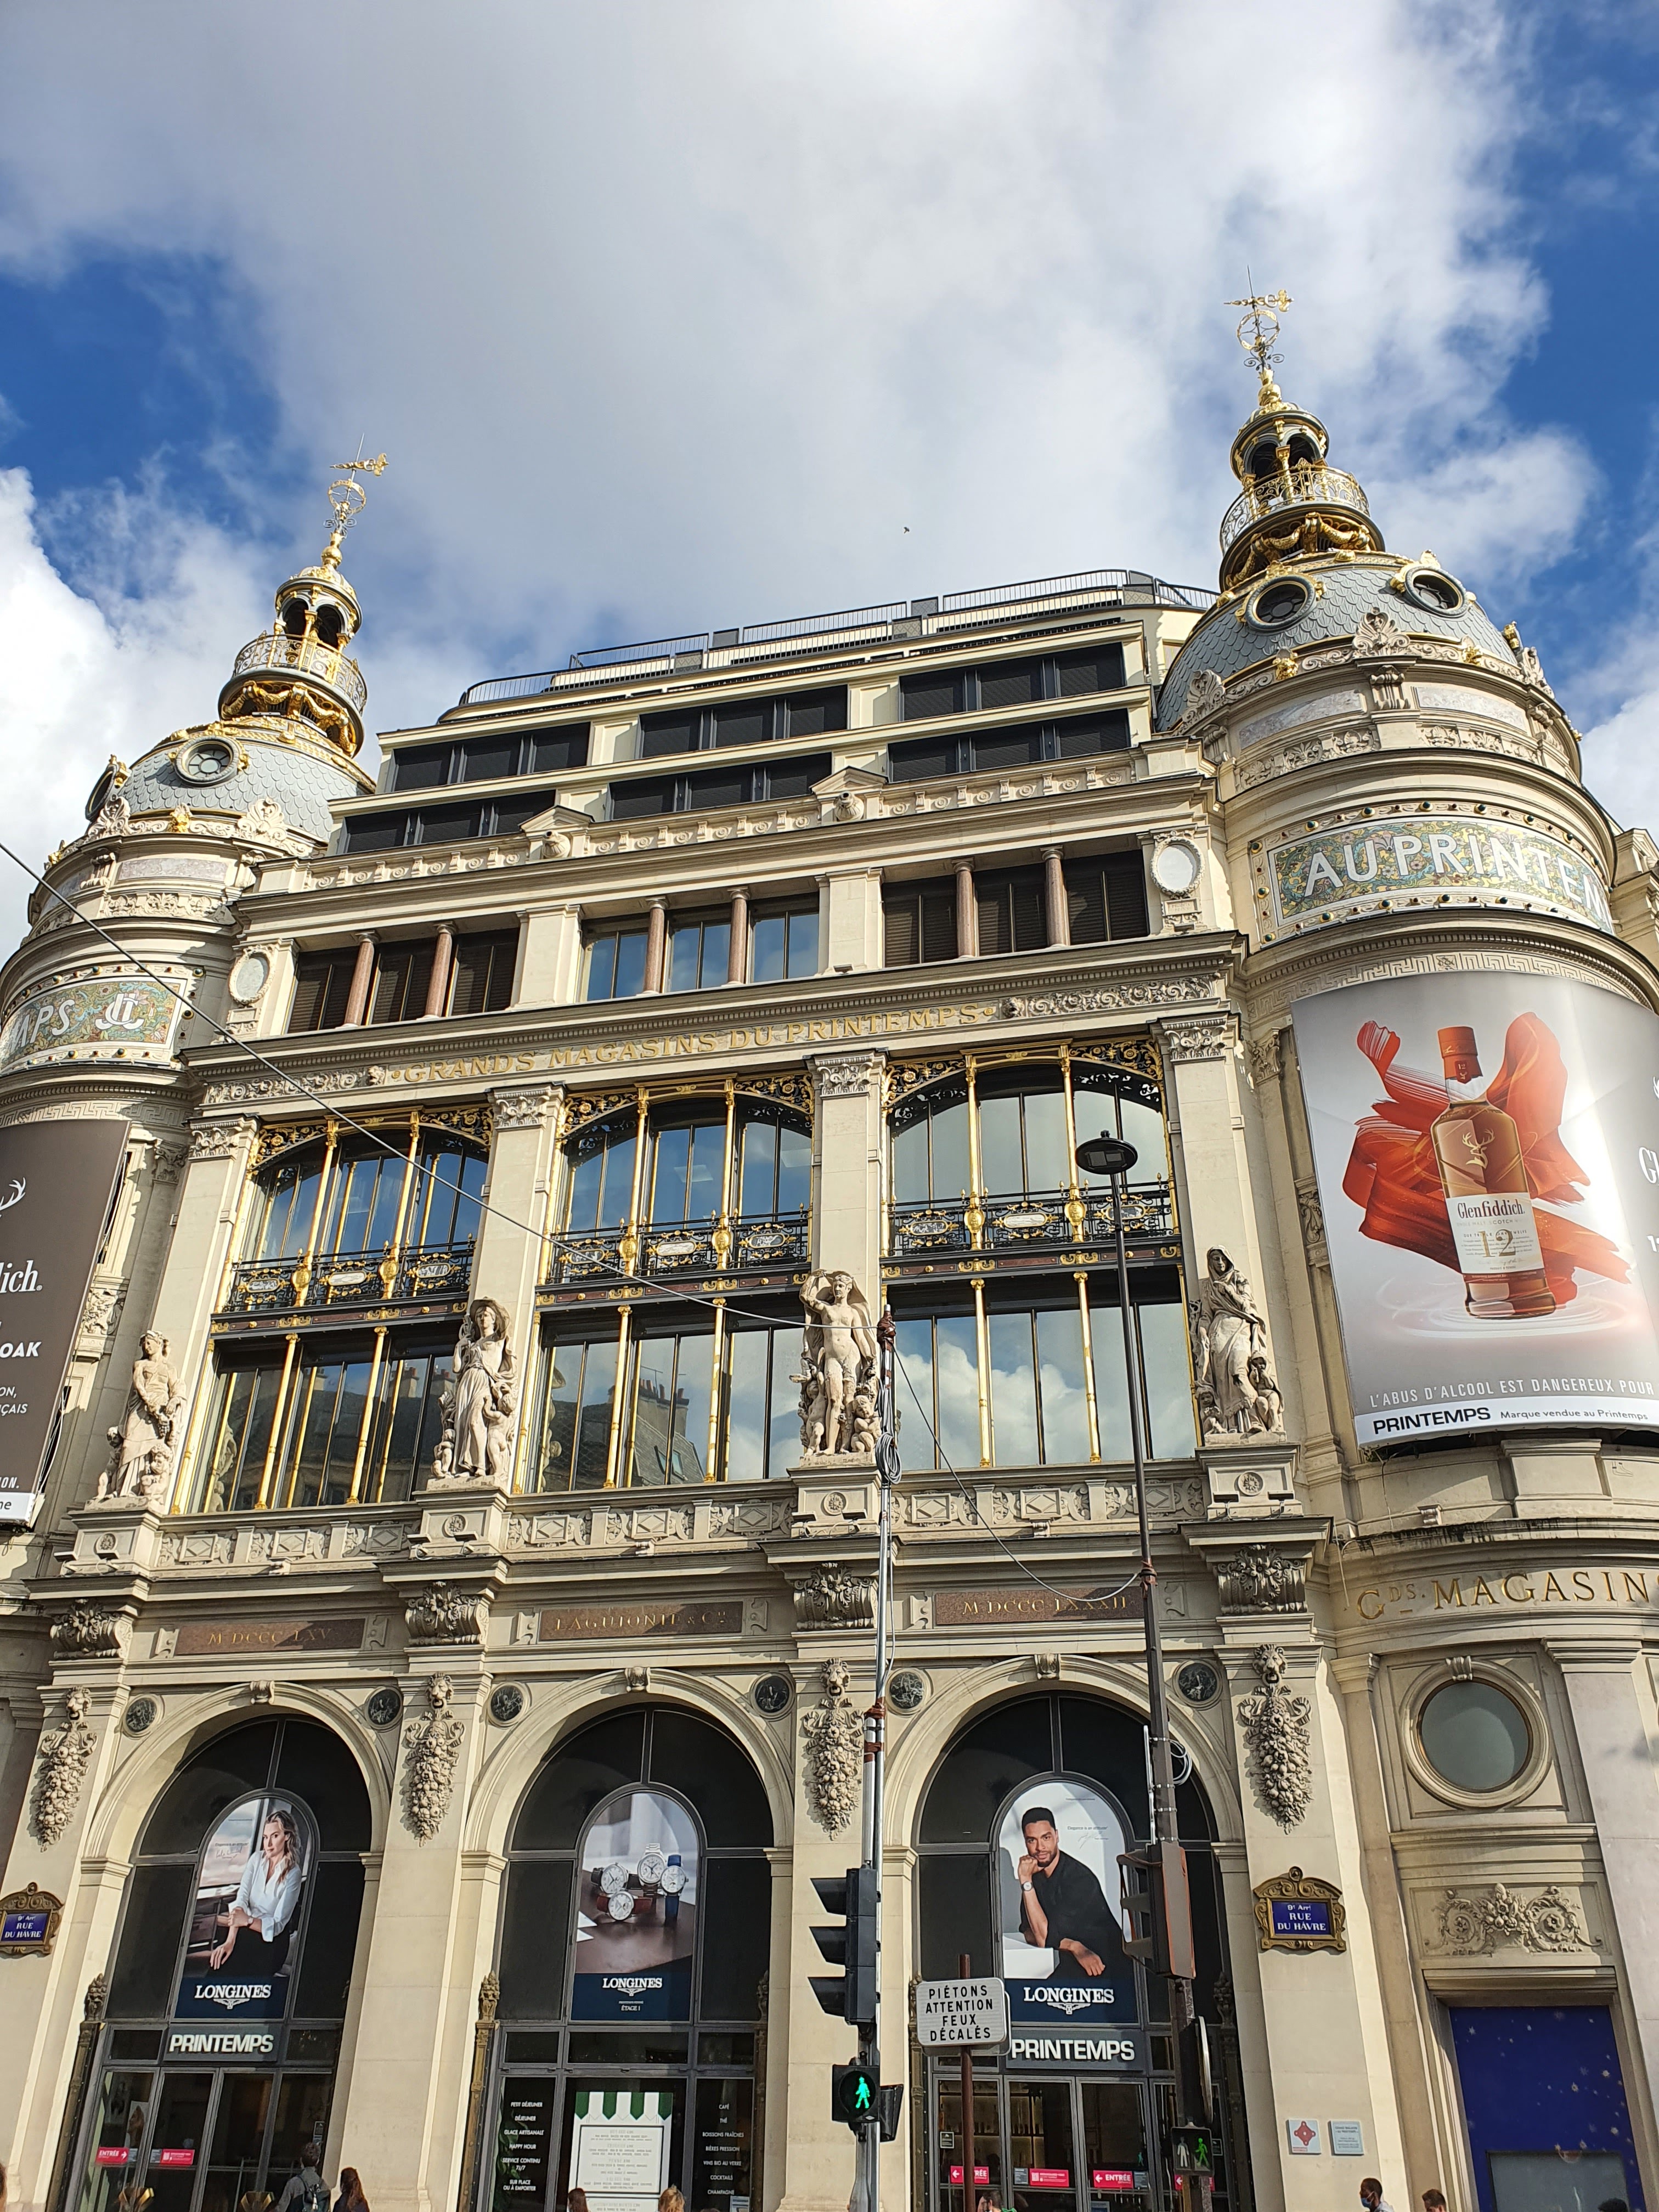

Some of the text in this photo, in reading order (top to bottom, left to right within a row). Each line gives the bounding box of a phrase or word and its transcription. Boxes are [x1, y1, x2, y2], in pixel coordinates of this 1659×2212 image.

[1304, 834, 1610, 928] AU PRINTEM
[404, 1002, 979, 1083] GRANDS MAGASINS DU PRINTEMPS
[1477, 1229, 1516, 1258] 12
[1370, 1378, 1654, 1408] L'ABUS D'ALCOOL EST DANGEREUX POUR
[0, 1403, 28, 1416] ÇAIS
[1373, 1407, 1491, 1435] PRINTEMPS
[1500, 1411, 1541, 1420] Marque
[1598, 1409, 1648, 1421] Printemps
[1431, 1571, 1659, 1610] MAGASIN
[962, 1601, 979, 1615] M
[988, 1599, 1044, 1615] DCCC
[555, 1612, 681, 1632] LAGUIONIE
[207, 1632, 222, 1645] M
[231, 1631, 283, 1644] DCCC
[194, 1984, 272, 1999] LONGINES
[602, 1978, 663, 1989] LONGINES
[929, 1985, 988, 2000] PIÉTONS
[1024, 1987, 1115, 2004] LONGINES
[926, 1999, 993, 2014] ATTENTION
[943, 2014, 977, 2027] FEUX
[930, 2025, 991, 2041] DÉCALÉS
[169, 2034, 274, 2053] PRINTEMPS
[1011, 2039, 1135, 2061] PRINTEMPS
